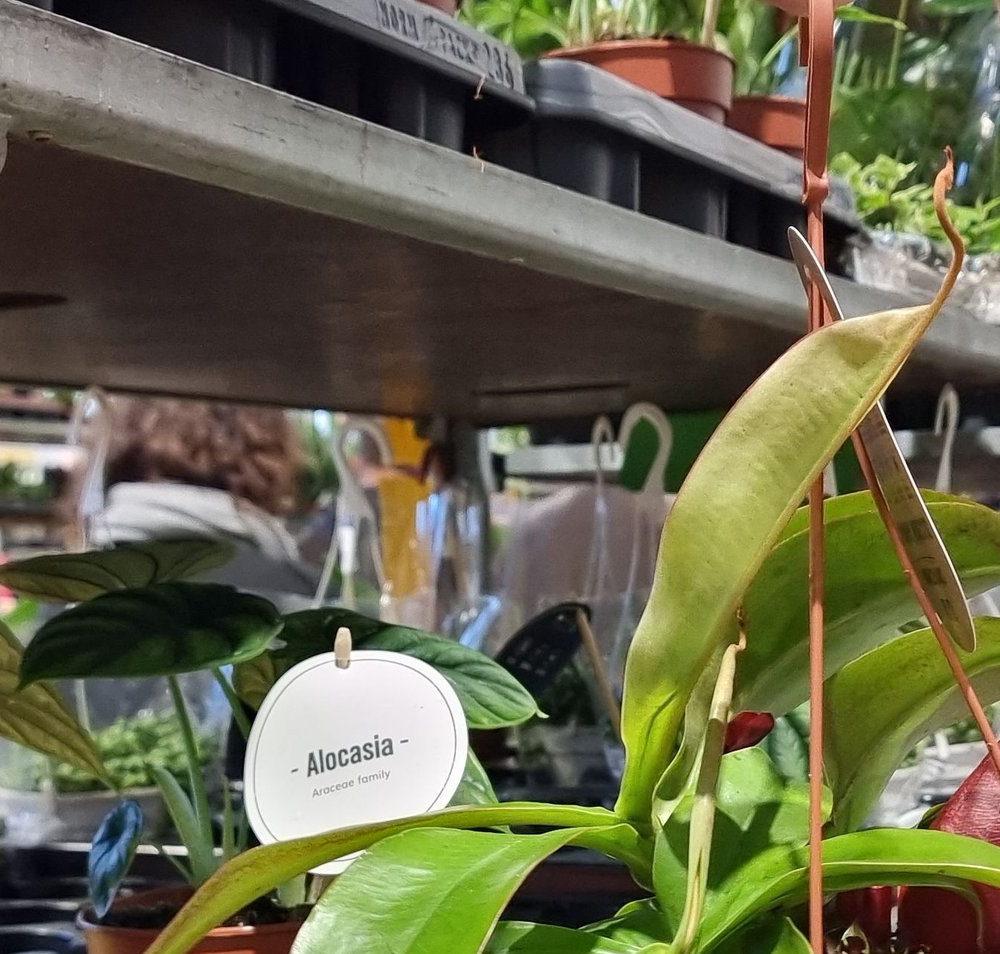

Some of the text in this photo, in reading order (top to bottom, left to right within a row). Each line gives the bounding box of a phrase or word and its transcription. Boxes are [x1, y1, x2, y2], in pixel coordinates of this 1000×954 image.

[307, 734, 394, 778] Alocasia
[312, 769, 391, 798] Araceae family
